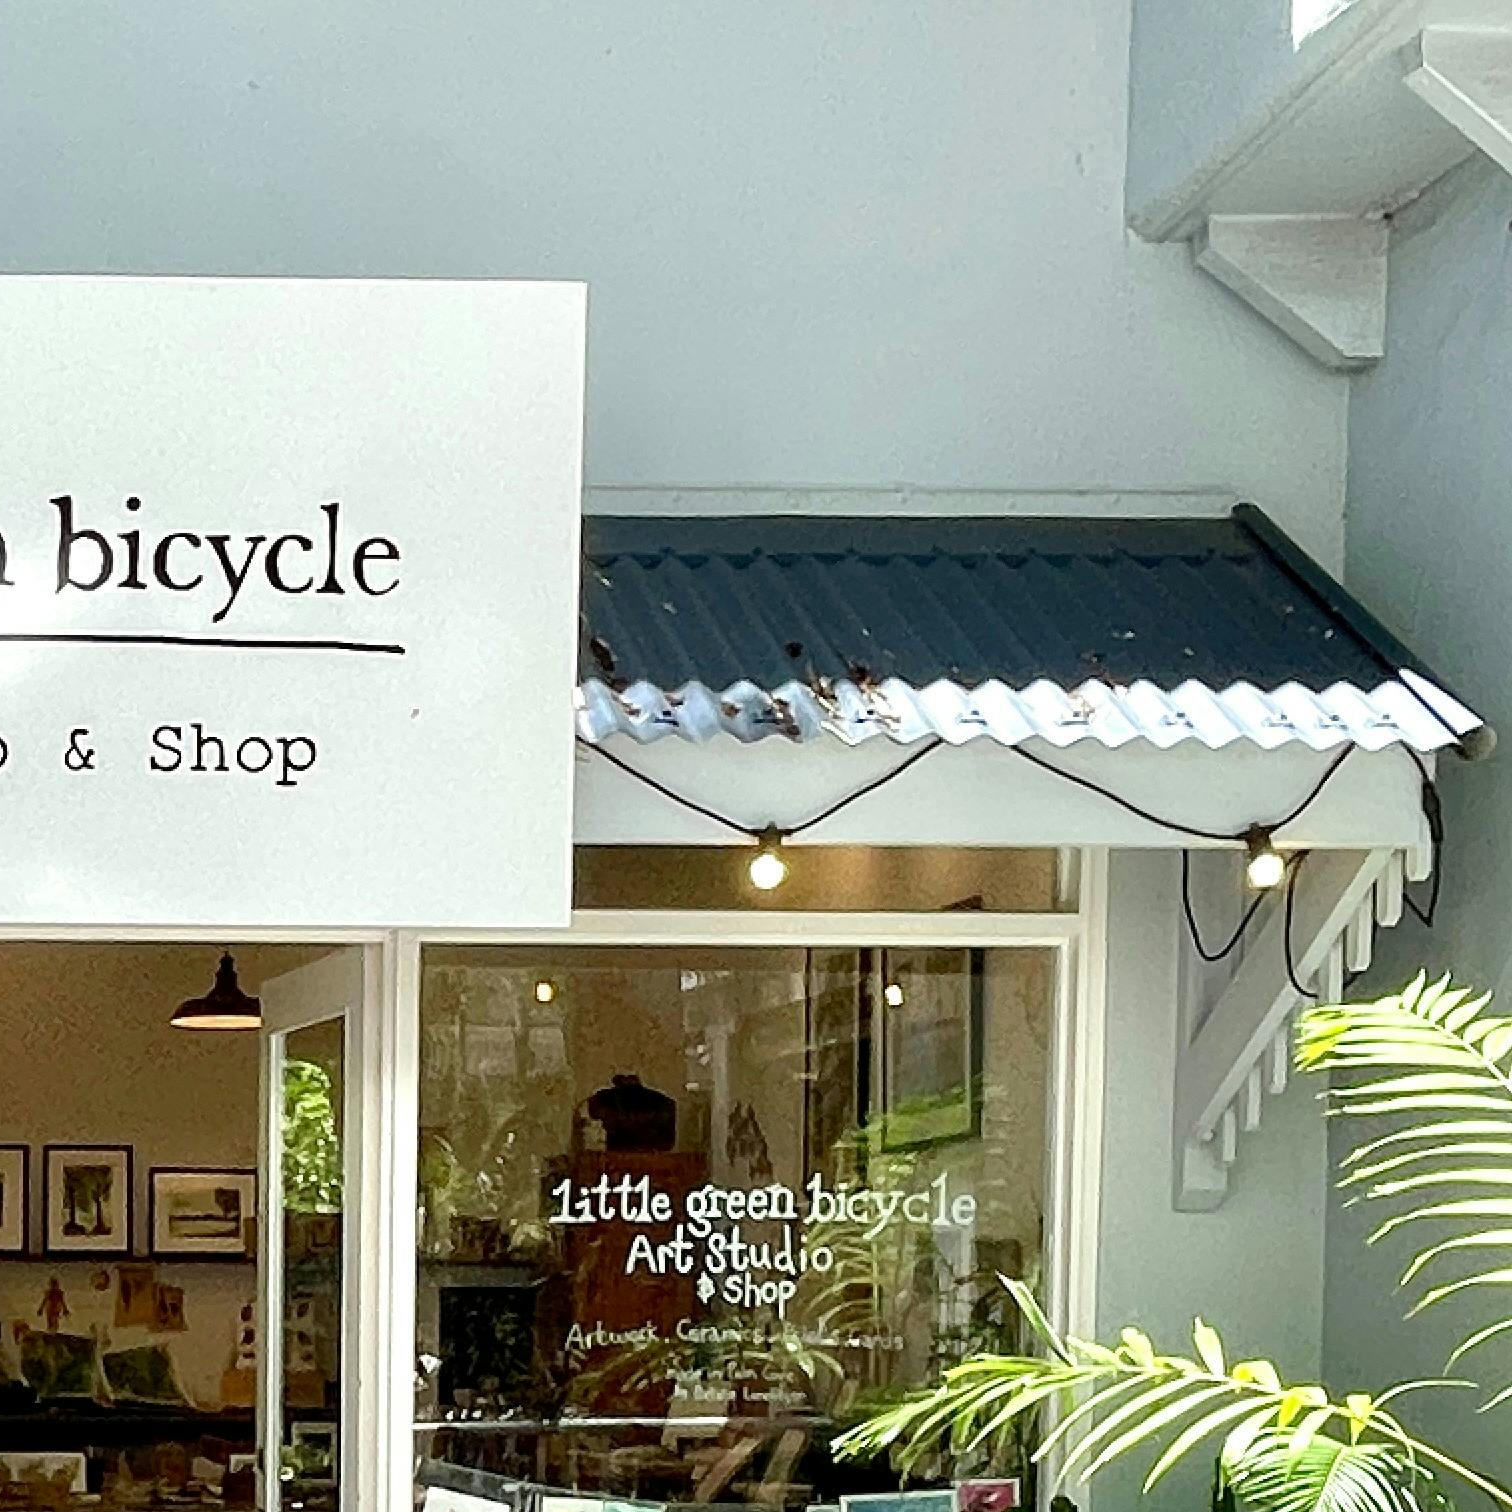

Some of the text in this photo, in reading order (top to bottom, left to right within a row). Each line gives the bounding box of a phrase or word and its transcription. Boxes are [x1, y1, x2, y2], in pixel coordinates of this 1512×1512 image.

[49, 495, 399, 623] bicycle
[65, 729, 95, 771] &
[151, 723, 315, 785] Shop
[551, 1171, 977, 1240] little green bicycle
[624, 1226, 835, 1276] Art Studio
[722, 1275, 796, 1319] Shop
